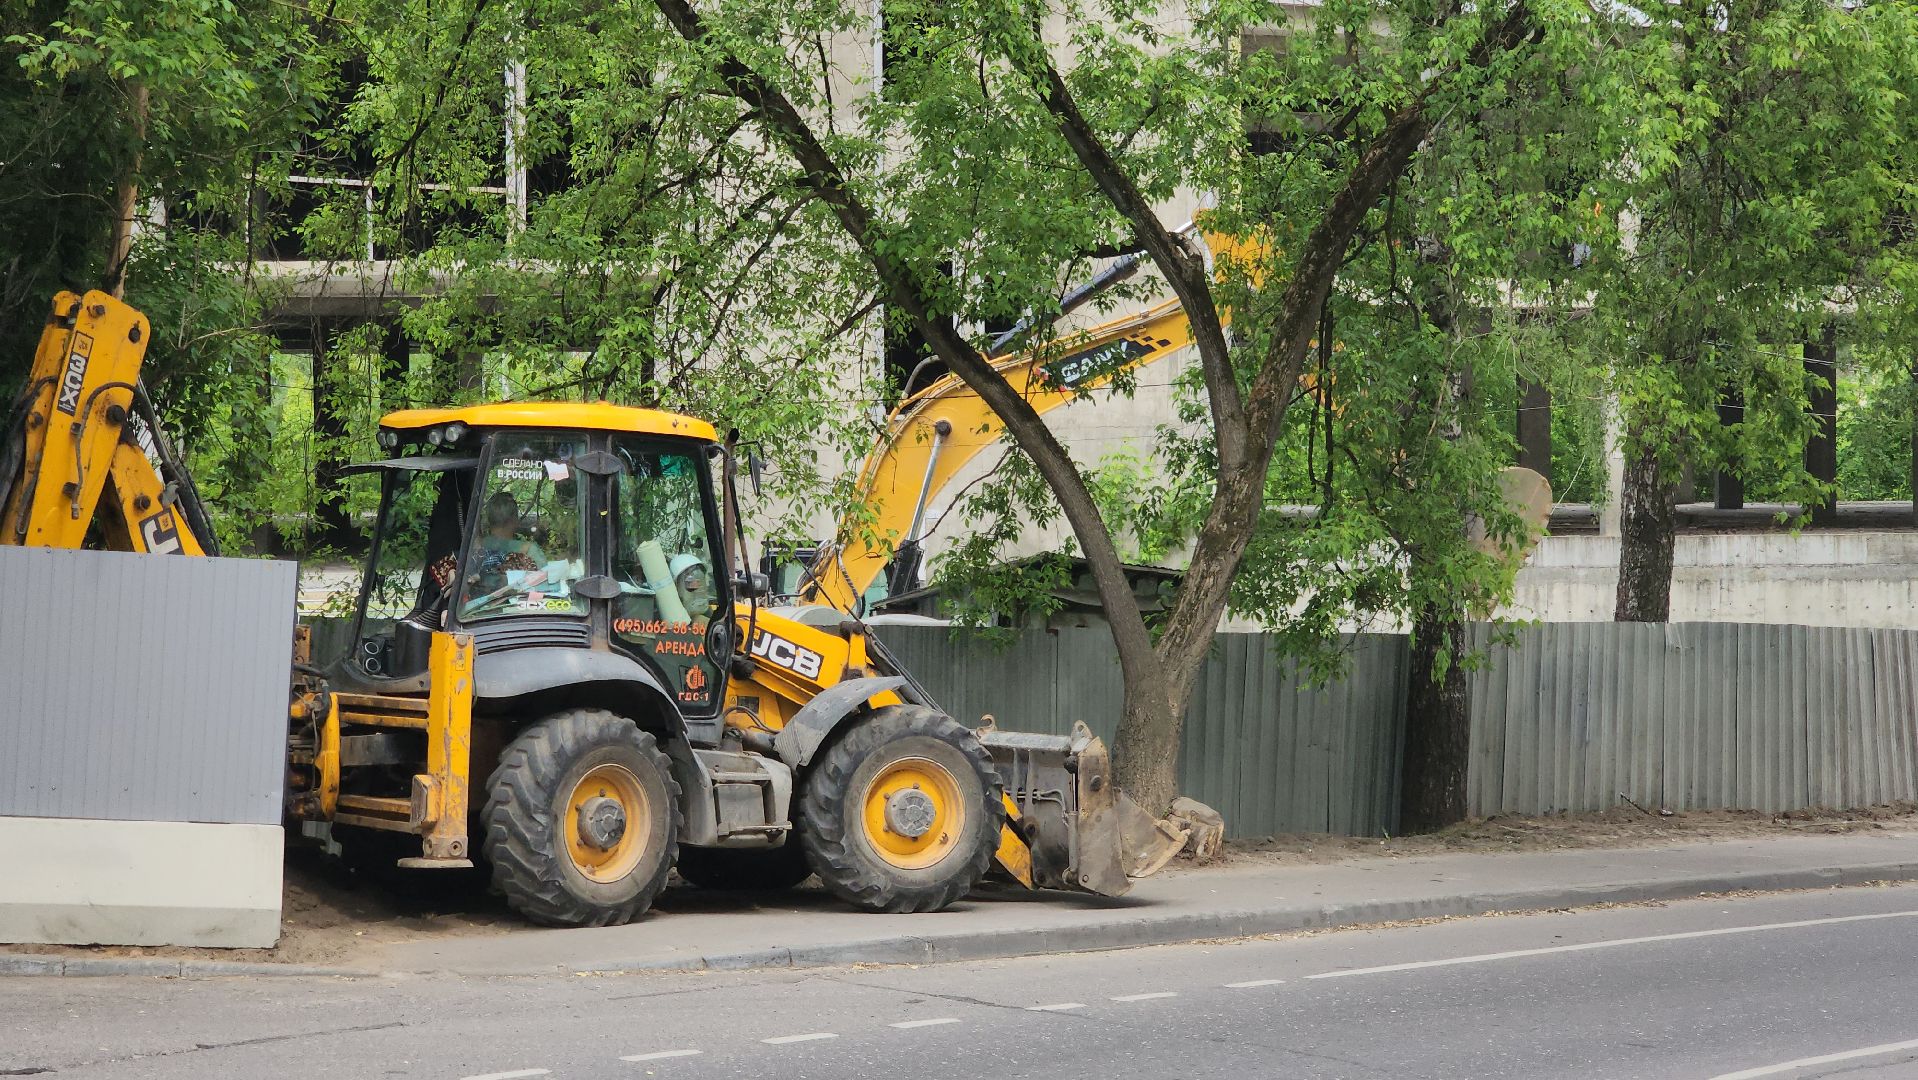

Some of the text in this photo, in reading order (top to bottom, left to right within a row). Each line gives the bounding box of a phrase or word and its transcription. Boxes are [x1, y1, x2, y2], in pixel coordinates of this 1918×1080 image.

[59, 354, 86, 407] 3CX
[502, 458, 543, 469] СДЕЛАНО
[505, 469, 543, 480] РОССИИ
[655, 640, 706, 657] АРЕНДА
[751, 632, 821, 678] JCB
[678, 691, 709, 702] ГДС-1
